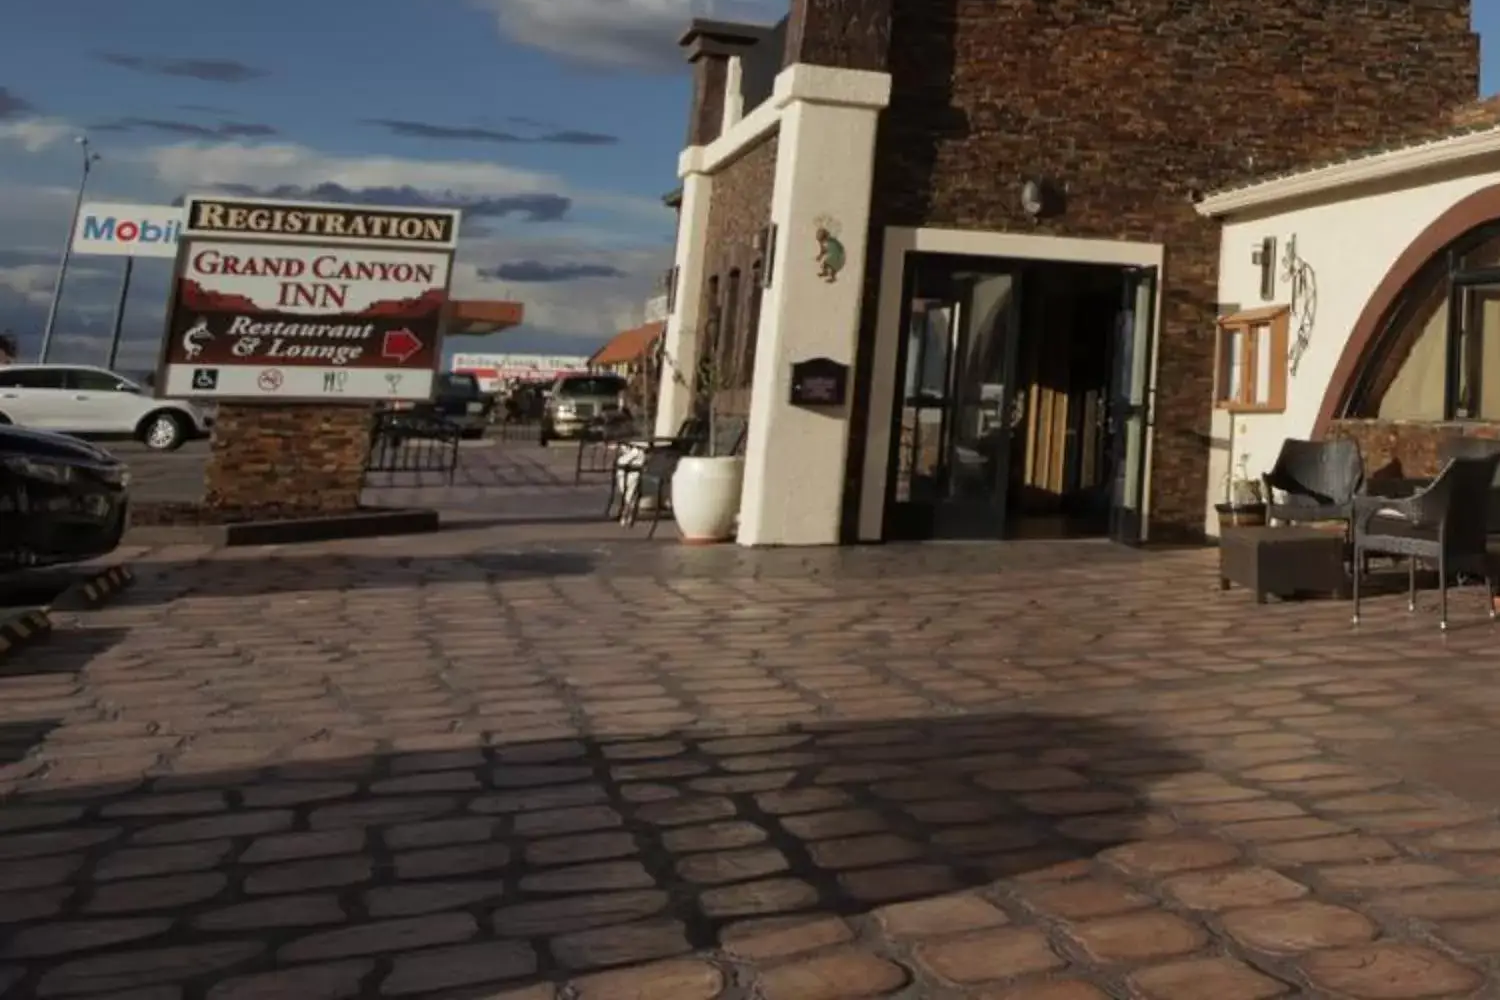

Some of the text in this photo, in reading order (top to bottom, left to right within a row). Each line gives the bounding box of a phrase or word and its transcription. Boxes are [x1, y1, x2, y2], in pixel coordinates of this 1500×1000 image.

[83, 215, 182, 244] Mobil
[198, 202, 447, 240] REGISTRATION
[193, 250, 436, 283] GRAND CANYON
[276, 282, 349, 308] INN
[226, 315, 375, 339] Restaurant
[232, 337, 364, 364] & Lounge
